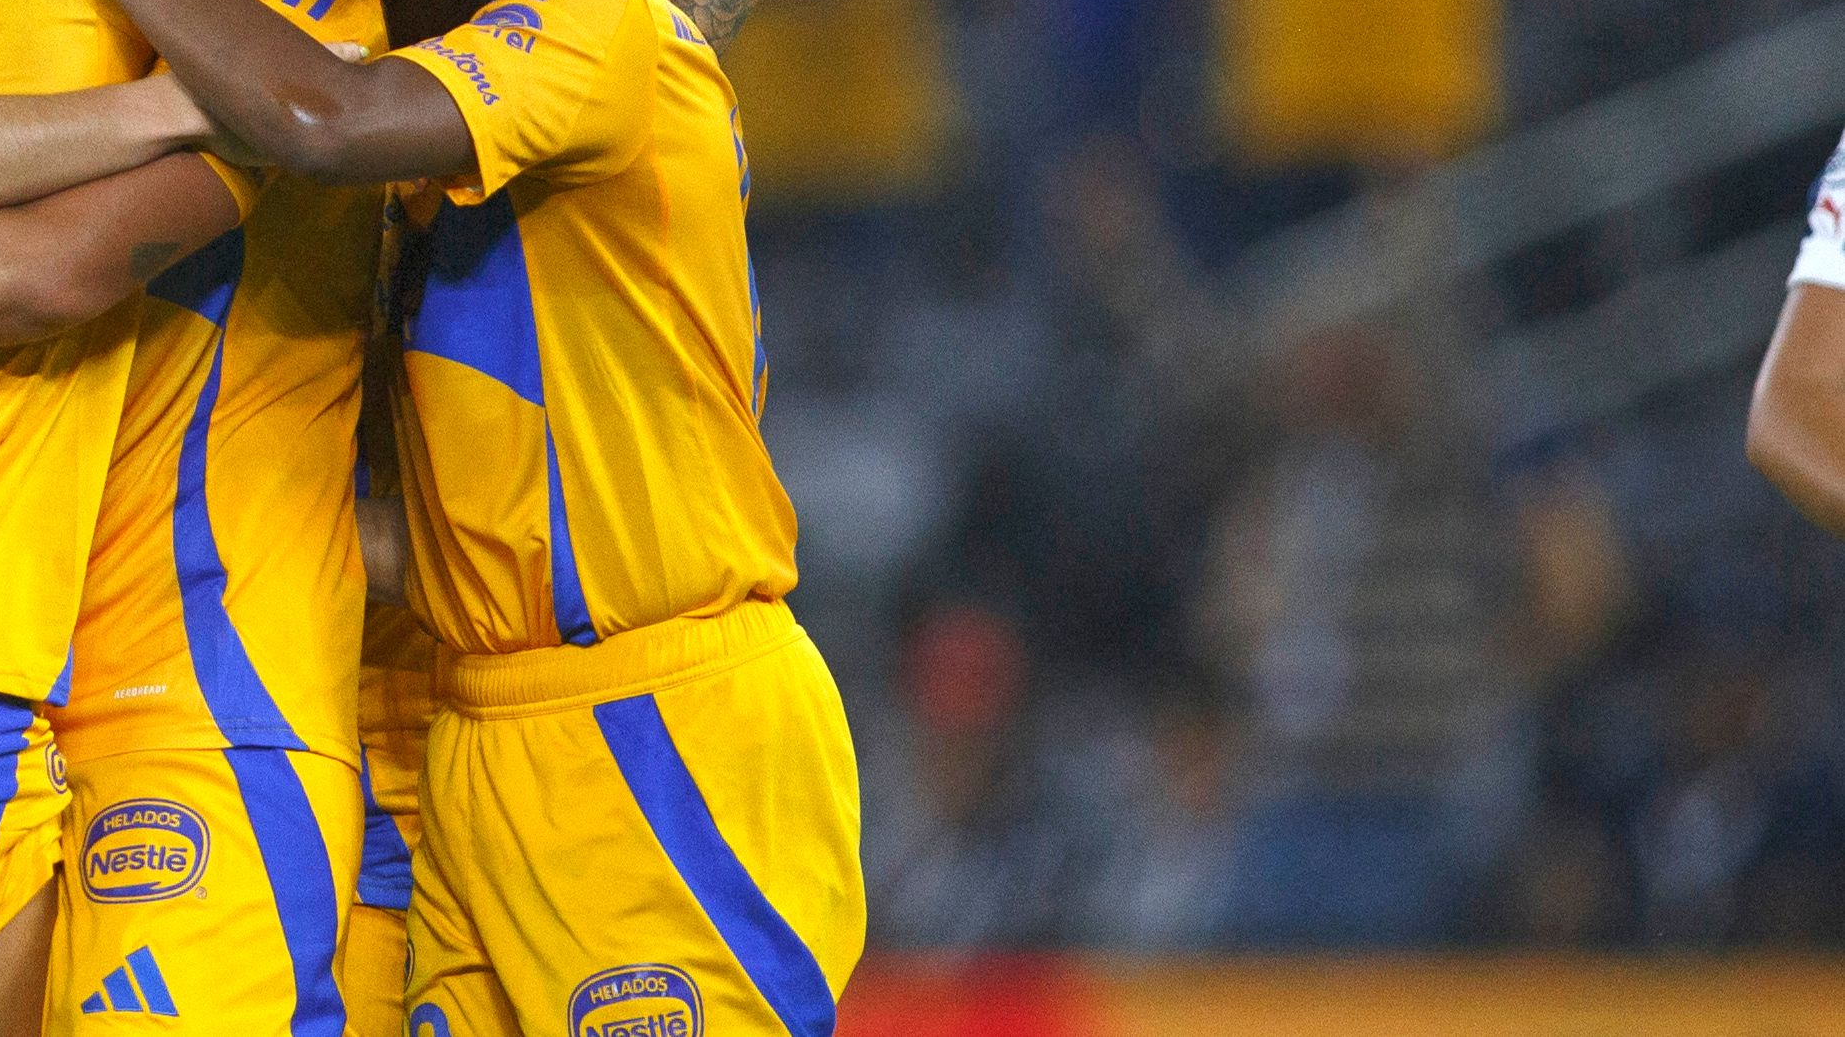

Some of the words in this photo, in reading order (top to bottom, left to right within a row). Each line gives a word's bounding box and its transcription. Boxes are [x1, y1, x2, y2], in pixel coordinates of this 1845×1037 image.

[114, 684, 167, 700] AEROREADY
[103, 810, 181, 832] HELADOS
[589, 976, 668, 1004] HELADOS
